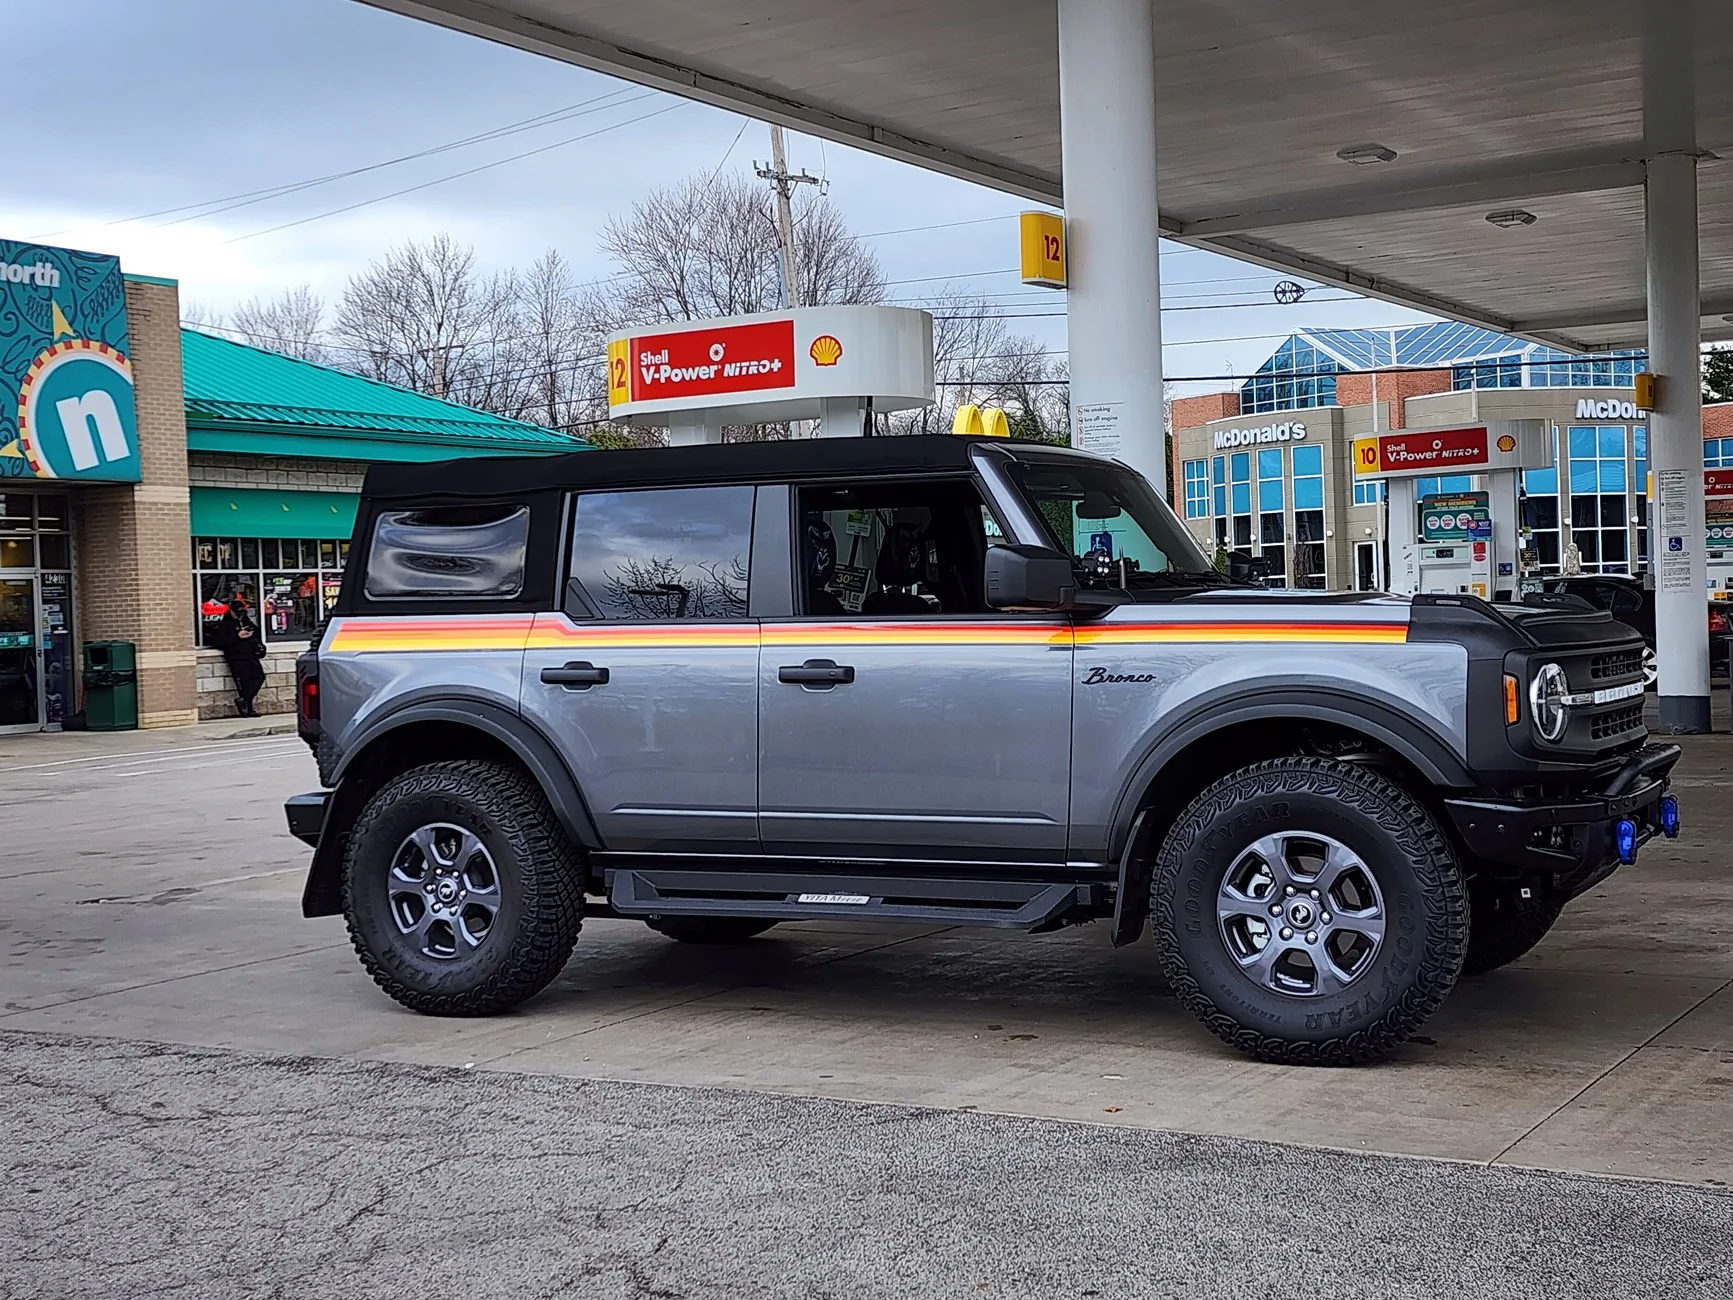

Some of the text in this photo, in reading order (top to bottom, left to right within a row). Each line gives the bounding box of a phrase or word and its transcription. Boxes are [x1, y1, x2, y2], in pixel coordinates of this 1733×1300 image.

[1044, 234, 1060, 262] 12
[640, 349, 669, 366] Shell
[609, 357, 626, 390] 12
[640, 364, 715, 385] V-Power
[1213, 421, 1306, 450] McDonald's
[1360, 446, 1377, 465] 10
[1386, 442, 1406, 452] Shell
[1387, 450, 1437, 463] V-Power
[1081, 666, 1157, 685] Bronco
